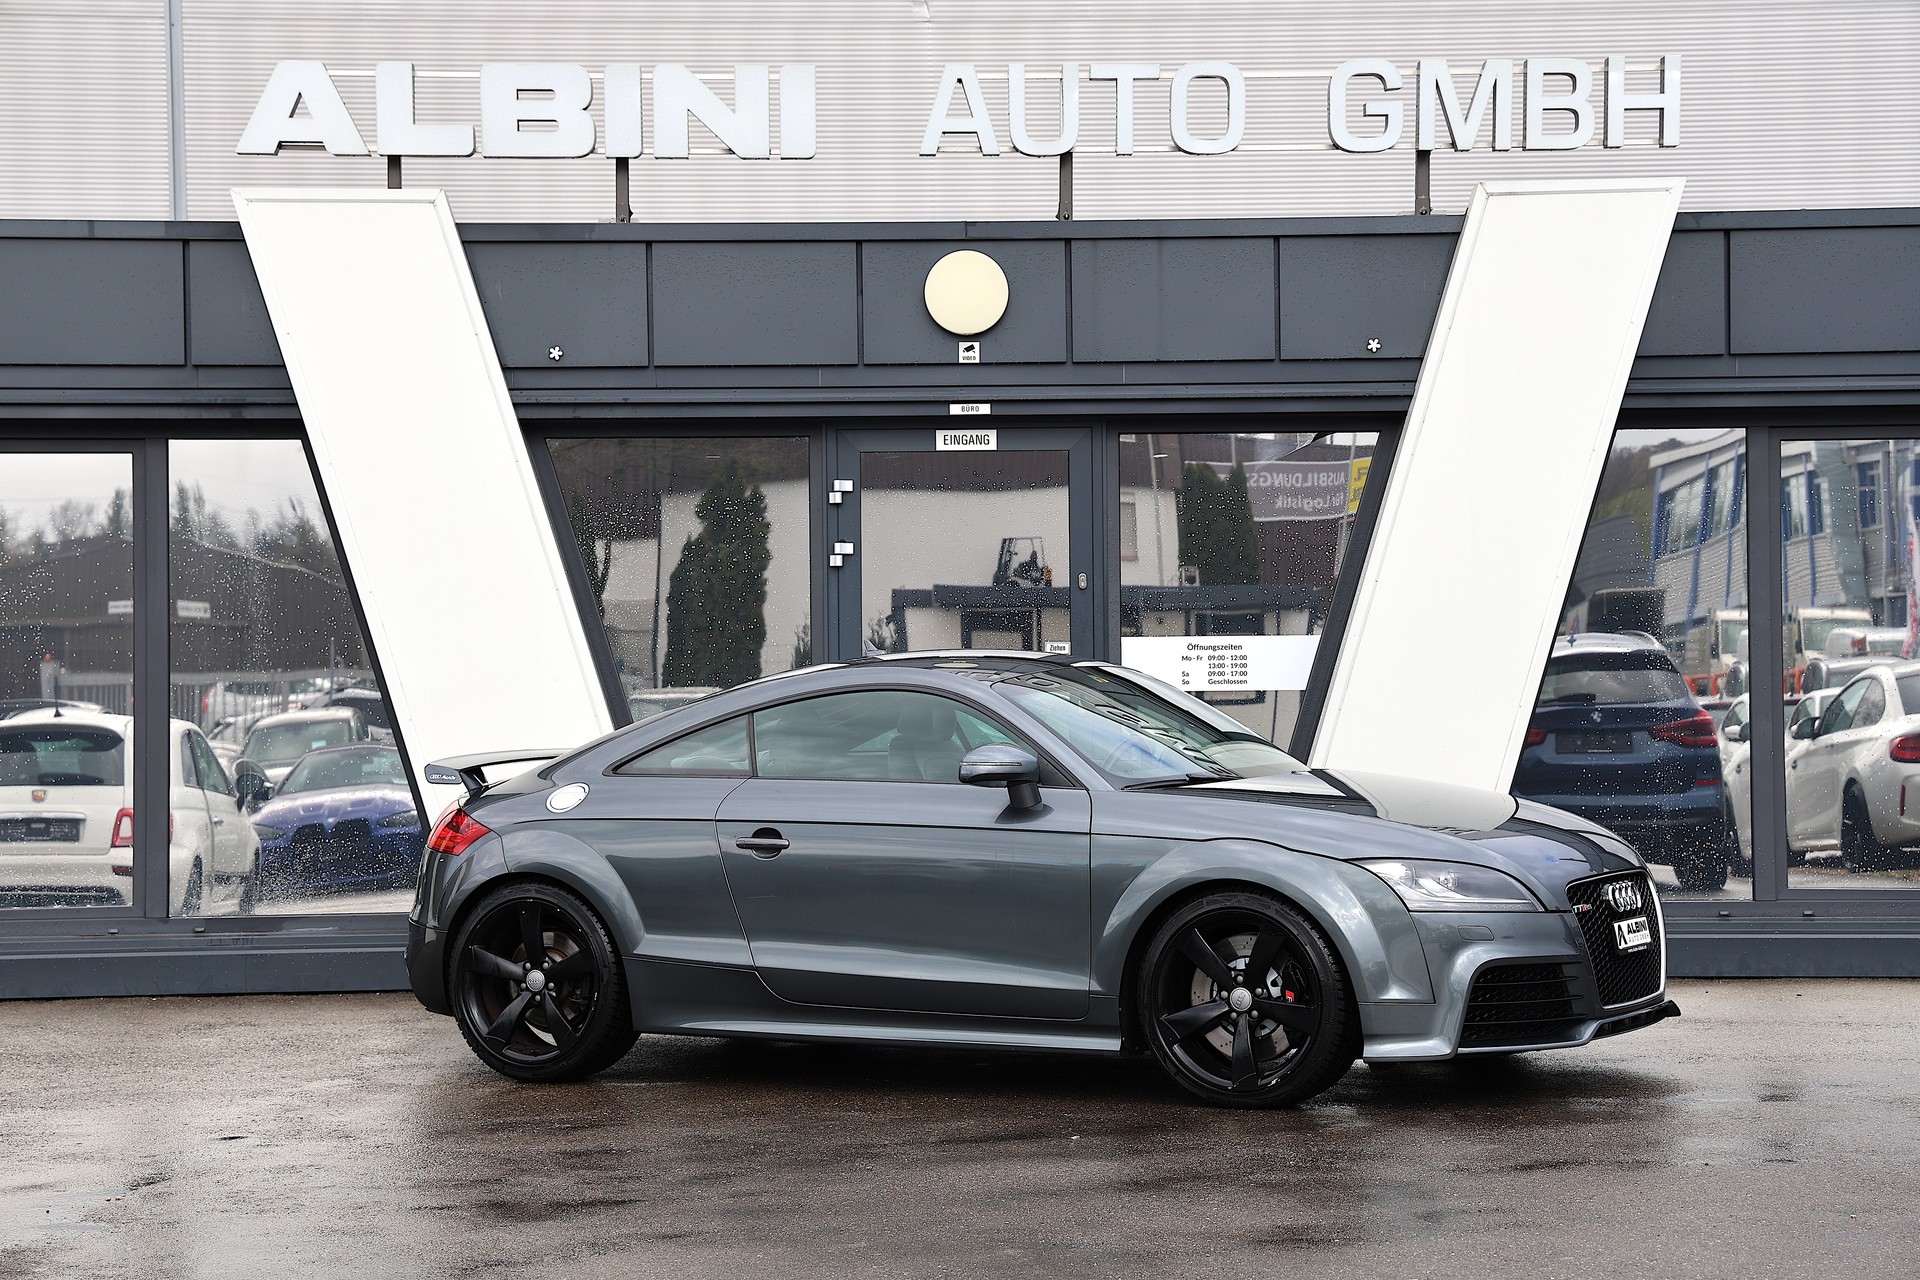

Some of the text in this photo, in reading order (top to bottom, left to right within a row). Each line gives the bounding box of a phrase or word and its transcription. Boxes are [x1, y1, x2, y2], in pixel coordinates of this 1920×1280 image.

[235, 54, 1682, 160] ALBINI AUTO GMBH
[943, 434, 990, 445] EINGANG
[1187, 643, 1242, 652] Öffnungszeiten
